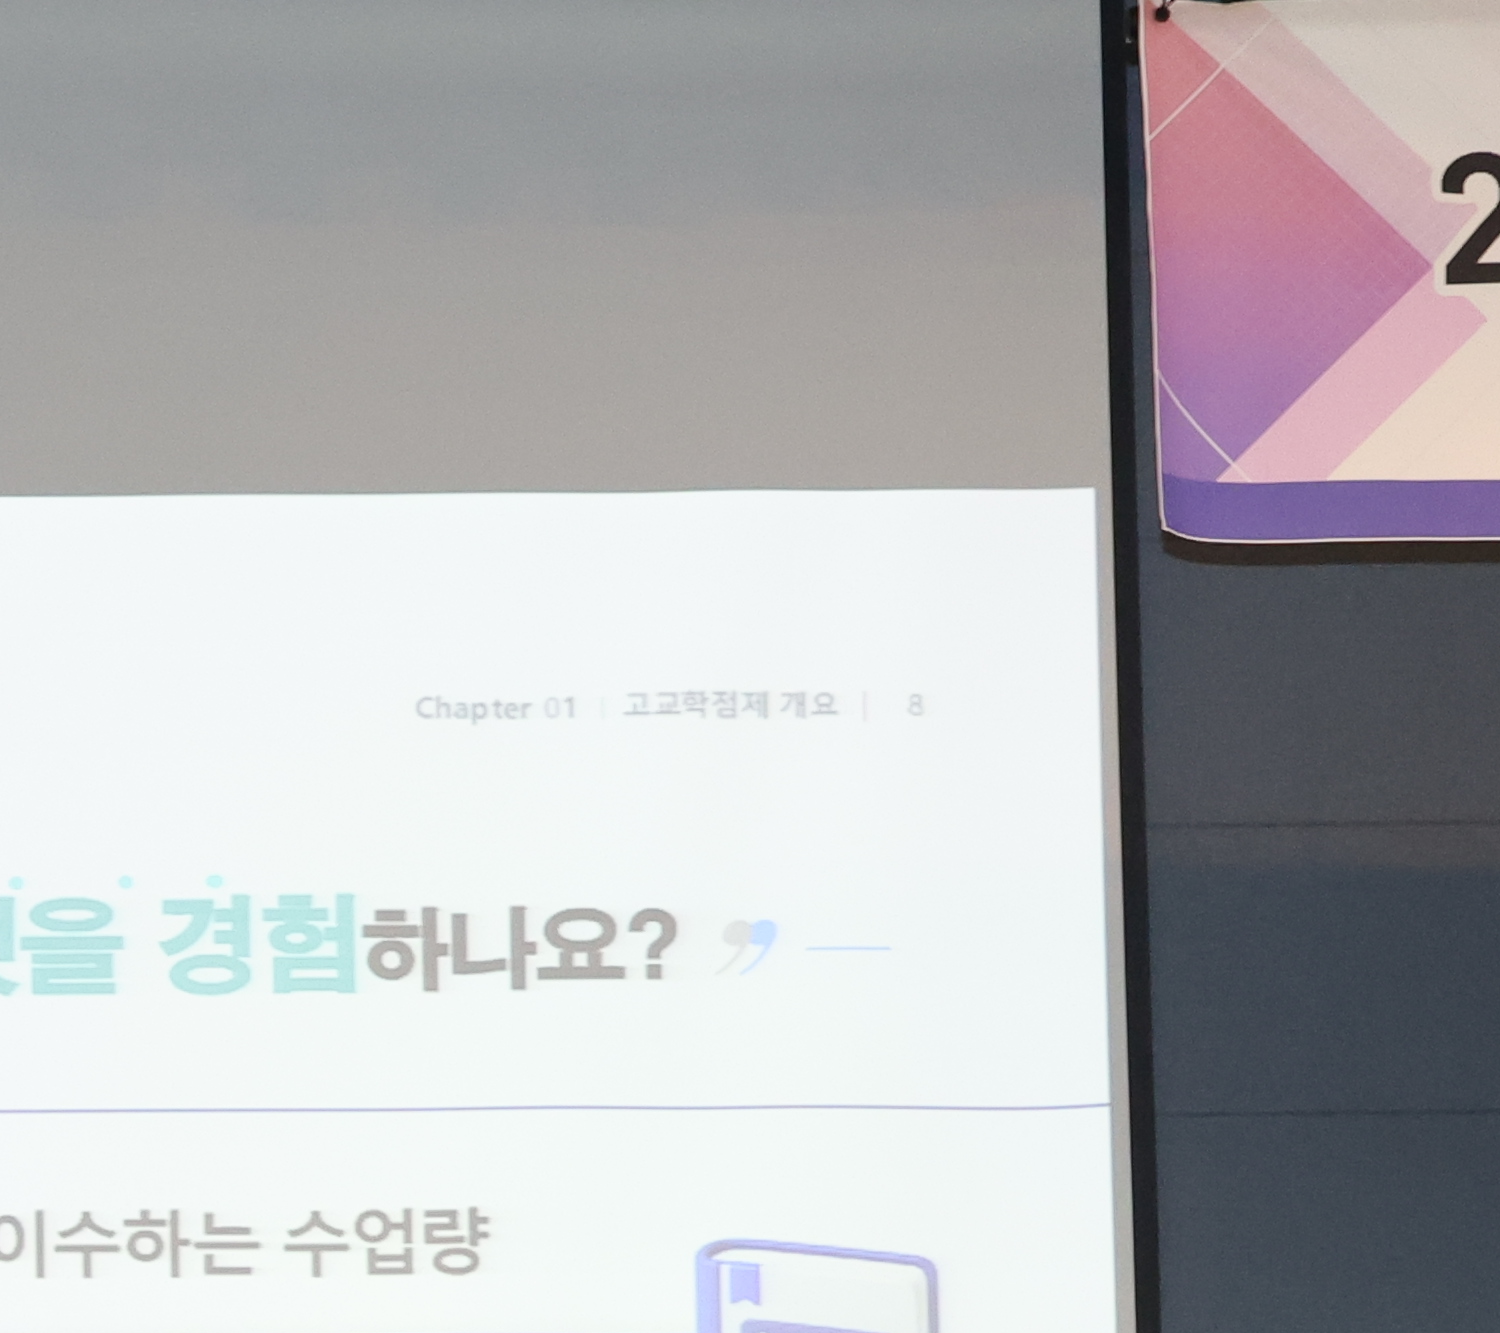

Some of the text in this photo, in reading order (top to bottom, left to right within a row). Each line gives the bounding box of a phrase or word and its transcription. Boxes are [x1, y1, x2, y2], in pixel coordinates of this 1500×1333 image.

[414, 695, 534, 726] Chapter
[543, 695, 576, 720] 01
[623, 689, 771, 720] 고교학점제
[779, 690, 840, 720] 개요
[157, 893, 681, 995] 경험하나요?
[283, 1206, 491, 1279] 수업량
